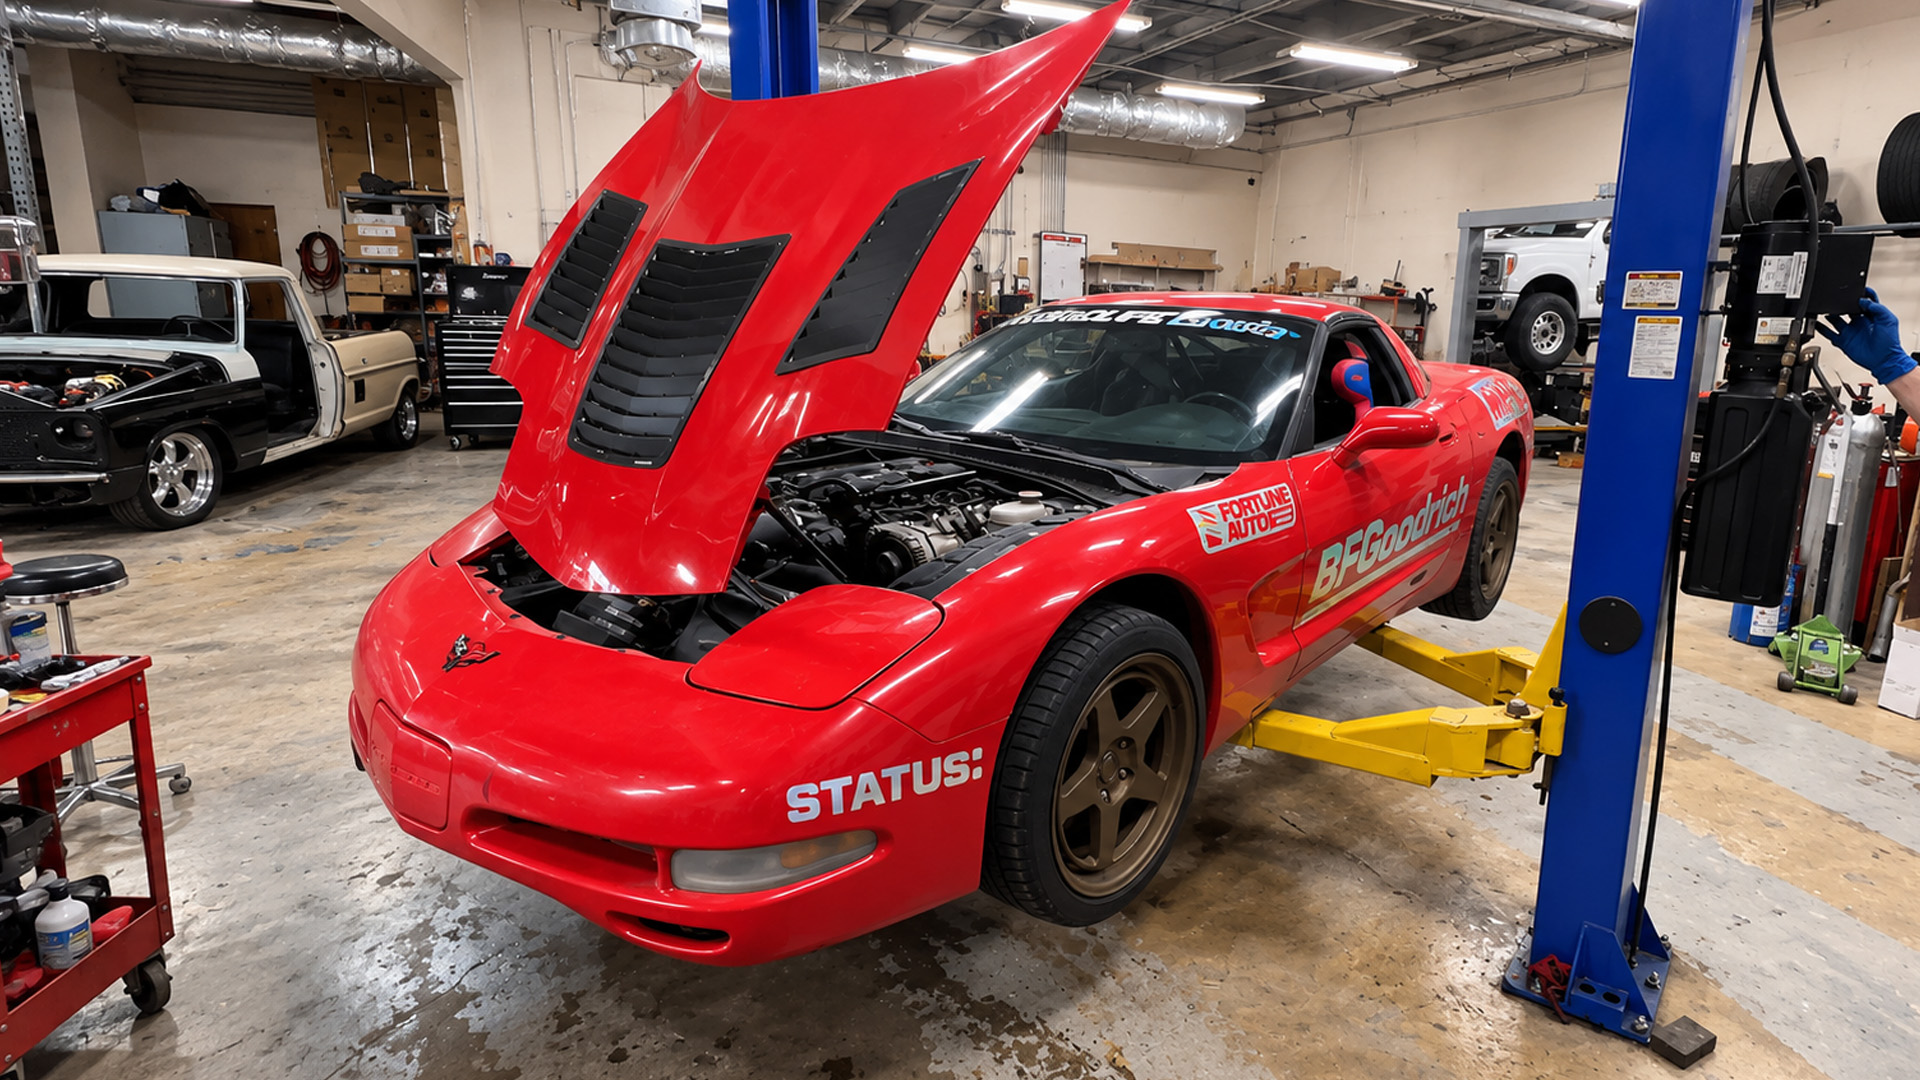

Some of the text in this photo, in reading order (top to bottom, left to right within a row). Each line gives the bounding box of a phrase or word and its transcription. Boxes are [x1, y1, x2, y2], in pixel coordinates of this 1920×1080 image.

[1217, 486, 1292, 523] FORTUNE
[1228, 512, 1269, 543] AUTO
[1308, 475, 1470, 604] BFGoodrich
[786, 747, 983, 823] STATUS:
